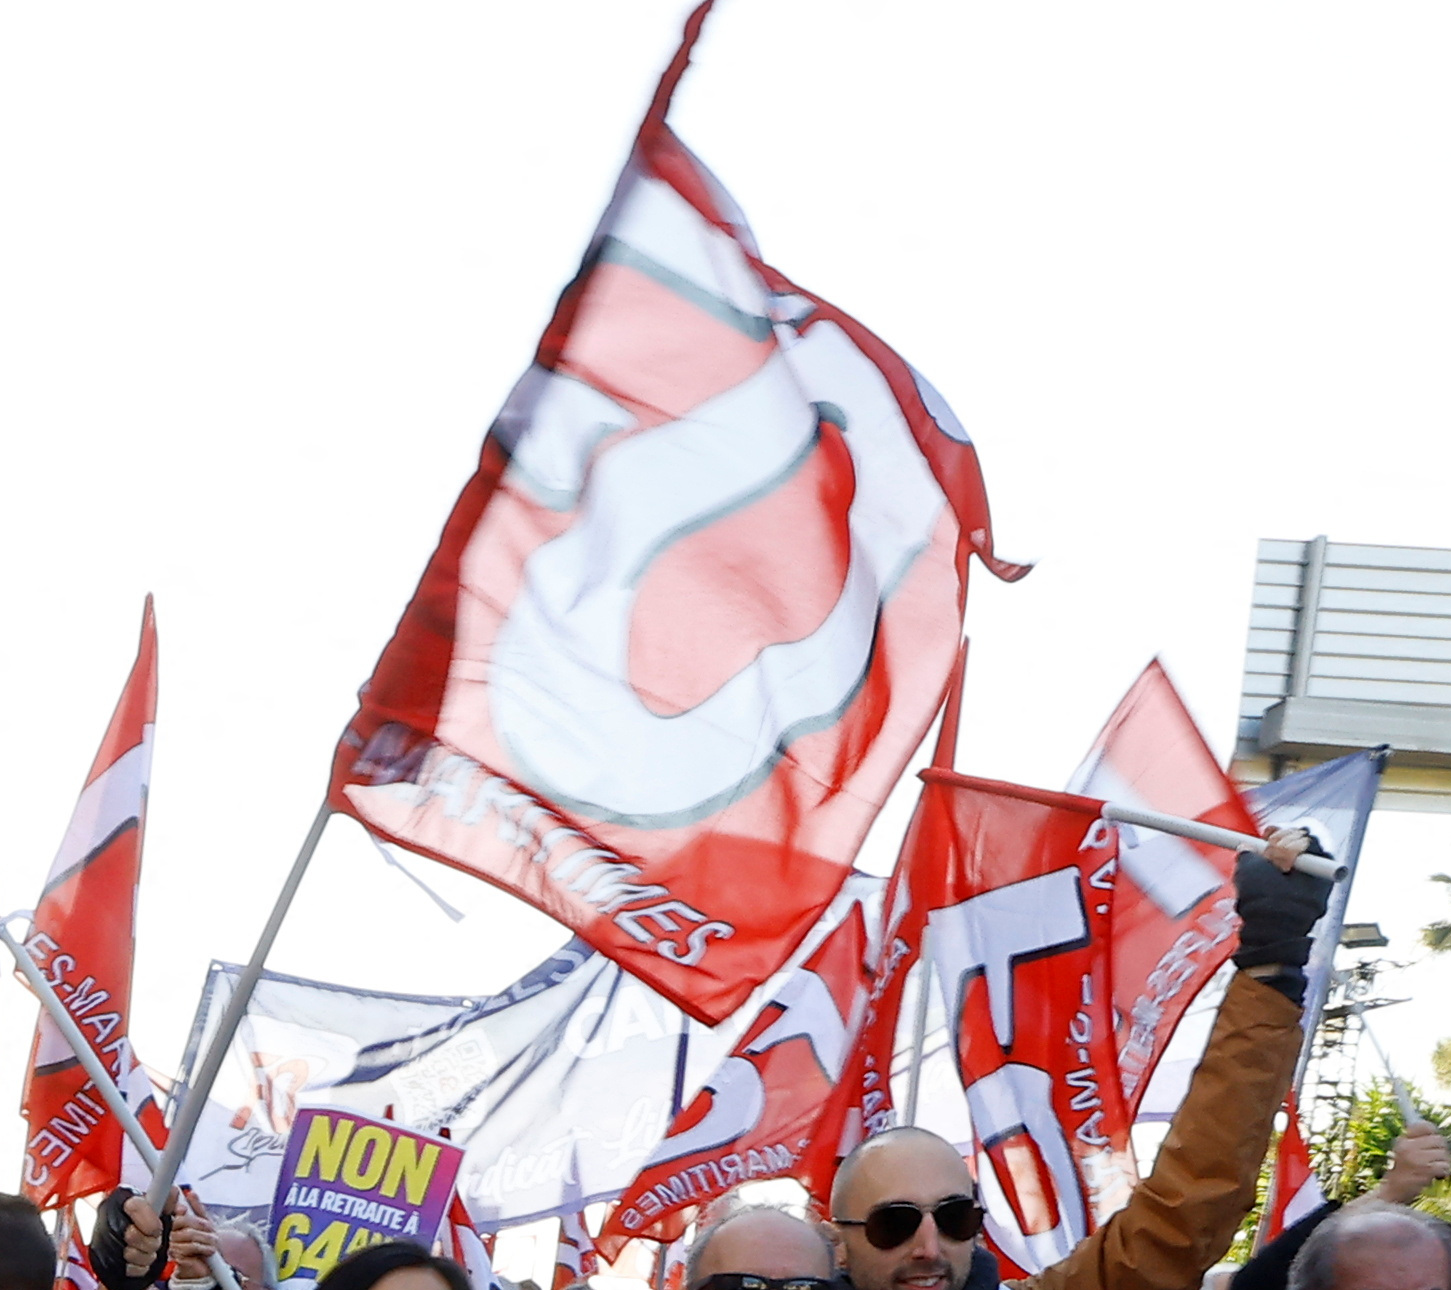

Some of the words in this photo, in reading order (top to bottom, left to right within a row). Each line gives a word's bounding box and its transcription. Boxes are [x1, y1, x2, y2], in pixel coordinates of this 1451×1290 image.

[296, 1114, 443, 1206] NON
[284, 1183, 298, 1207] À
[299, 1187, 321, 1209] LA
[320, 1190, 407, 1233] RETRAITE
[402, 1210, 421, 1236] À
[274, 1212, 351, 1284] 64
